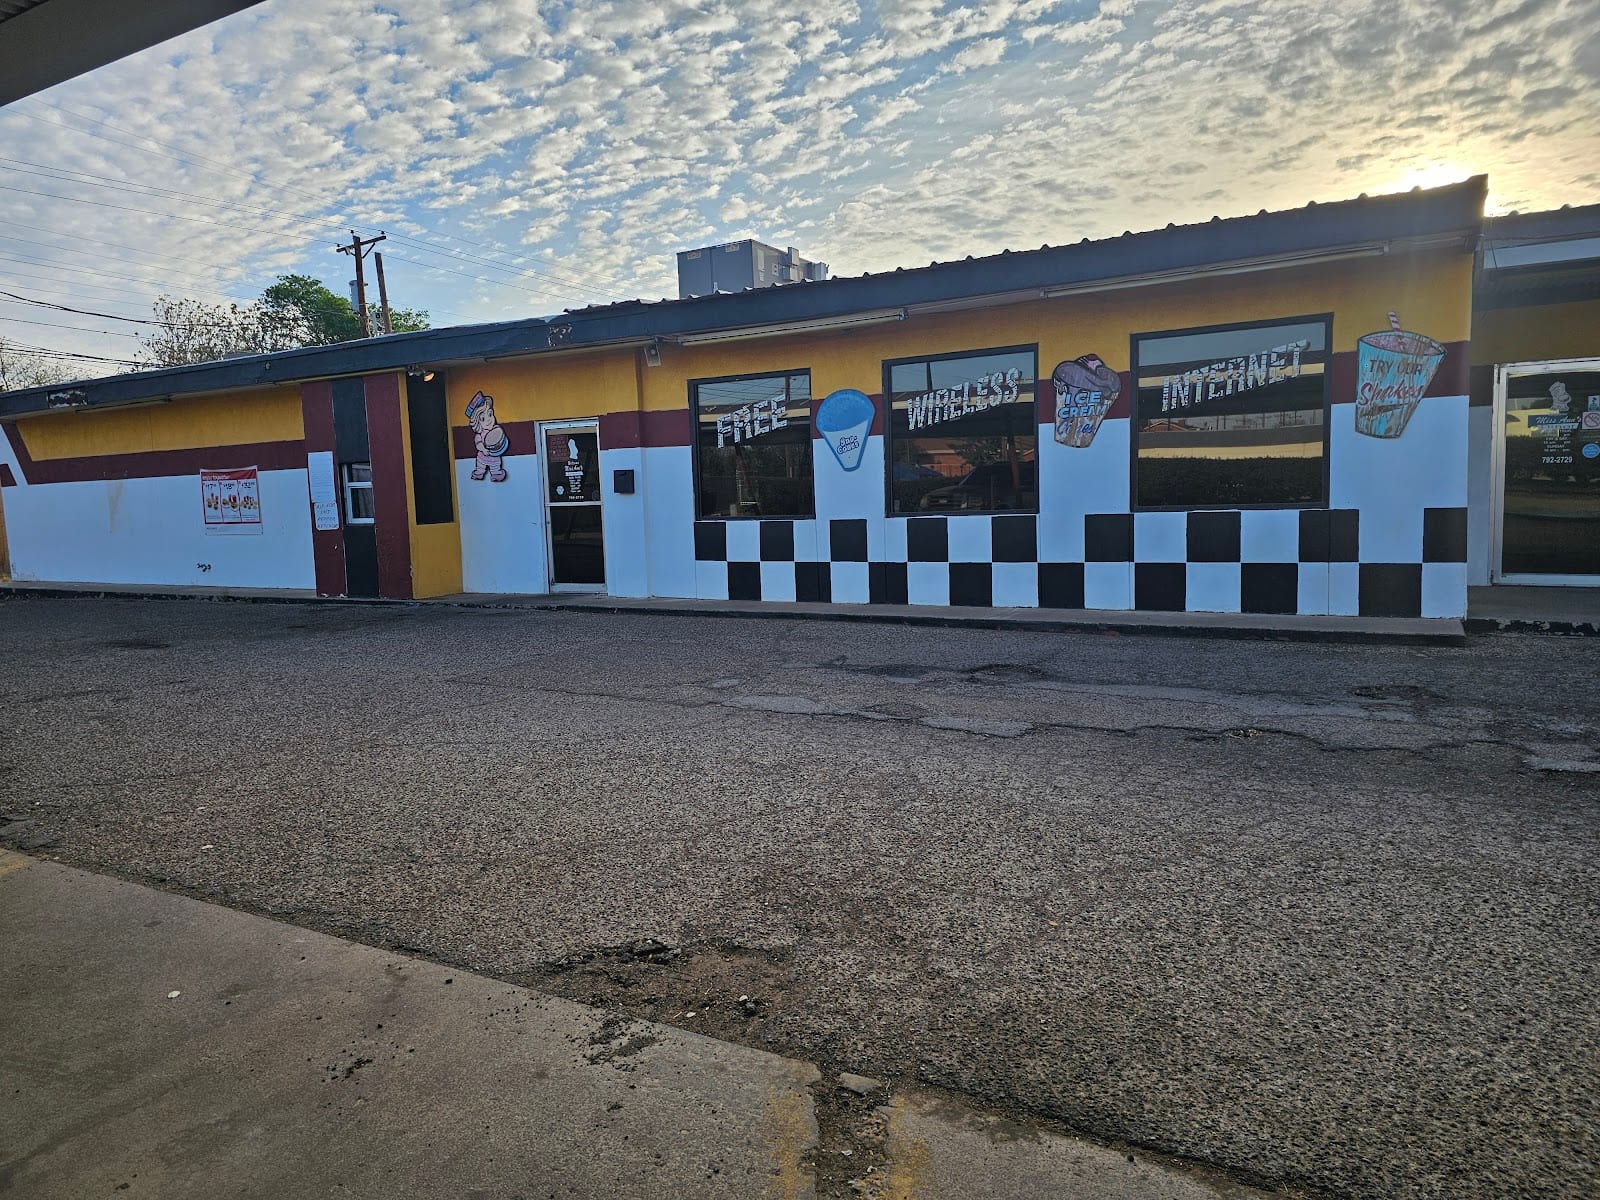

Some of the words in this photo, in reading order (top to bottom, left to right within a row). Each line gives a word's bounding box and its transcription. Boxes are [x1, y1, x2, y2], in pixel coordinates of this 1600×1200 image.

[1369, 359, 1394, 375] TRY
[1162, 340, 1309, 412] INTERNET
[906, 367, 1023, 431] WIRELESS
[1065, 390, 1102, 405] ICE
[1058, 404, 1108, 419] CREAM
[716, 394, 788, 449] FREE
[1057, 421, 1094, 435] Coes
[1541, 456, 1573, 464] 792-2729
